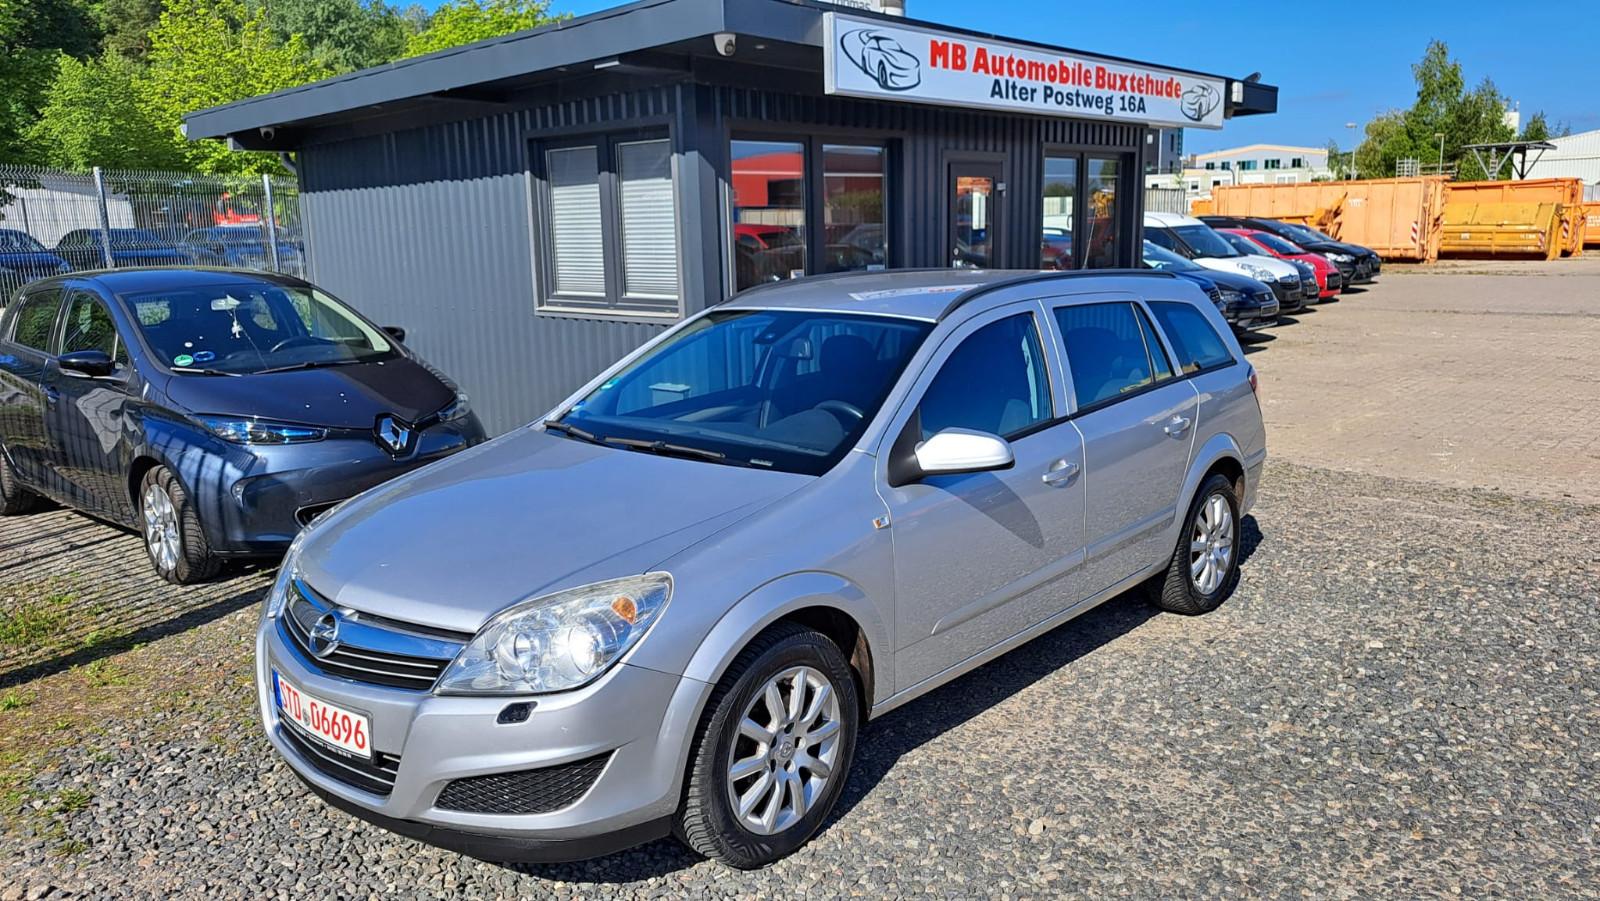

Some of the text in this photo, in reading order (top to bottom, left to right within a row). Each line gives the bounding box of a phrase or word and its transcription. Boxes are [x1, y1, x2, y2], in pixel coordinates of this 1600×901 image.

[930, 39, 1181, 98] MB Automobile Buxtehude
[990, 78, 1147, 115] Alter Postweg 16A
[279, 680, 302, 720] STD
[310, 701, 366, 749] 06696
